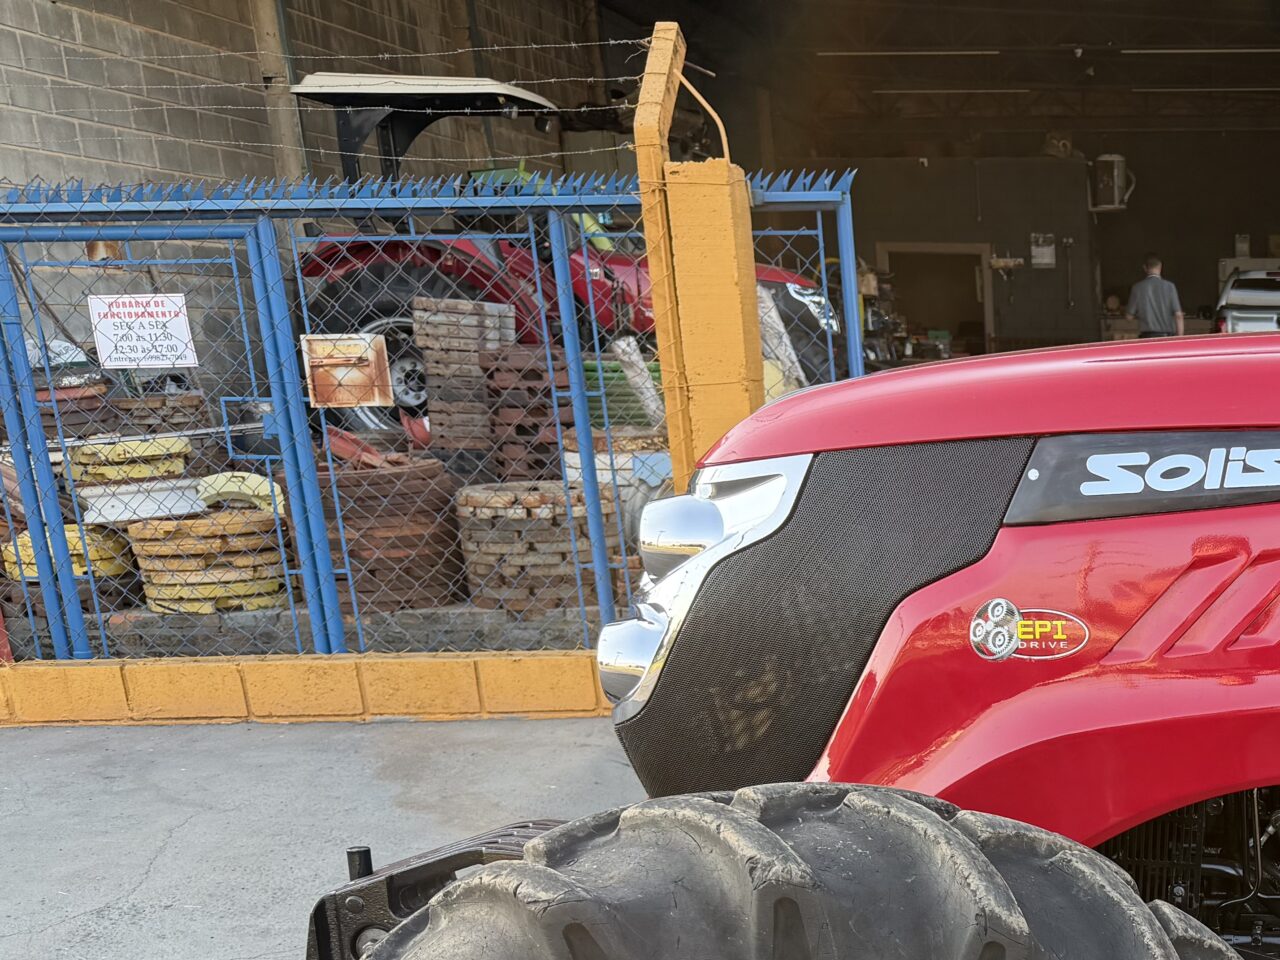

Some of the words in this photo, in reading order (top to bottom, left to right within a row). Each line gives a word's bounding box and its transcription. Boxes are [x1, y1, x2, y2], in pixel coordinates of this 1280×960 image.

[153, 300, 166, 308] DE
[97, 311, 181, 319] FUNCIONAMENTO
[138, 321, 146, 330] A
[1017, 620, 1067, 640] EPI
[1018, 641, 1068, 649] DRIVE
